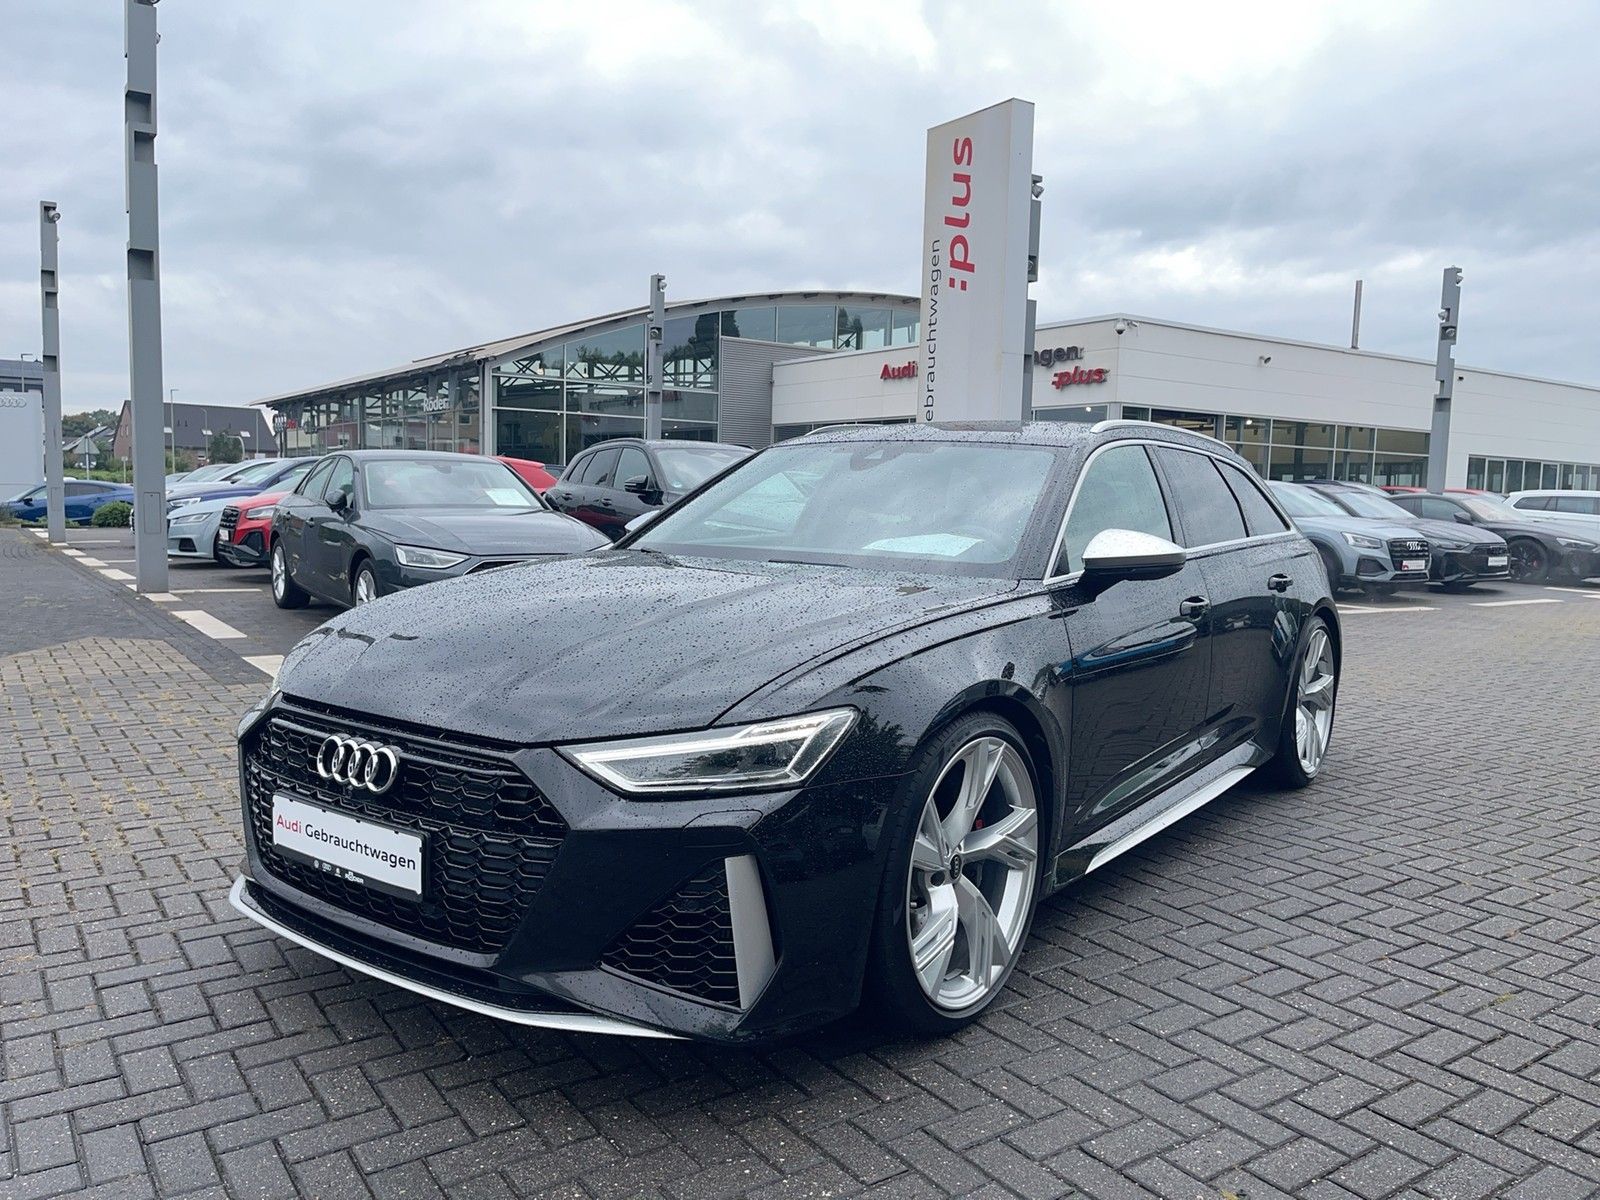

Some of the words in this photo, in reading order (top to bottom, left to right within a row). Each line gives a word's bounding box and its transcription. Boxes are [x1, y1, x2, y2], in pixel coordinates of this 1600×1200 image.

[924, 239, 942, 422] ebrauchtwagen
[880, 360, 918, 380] Audi
[276, 814, 302, 834] Audi
[305, 824, 416, 870] Gebrauchtwagen
